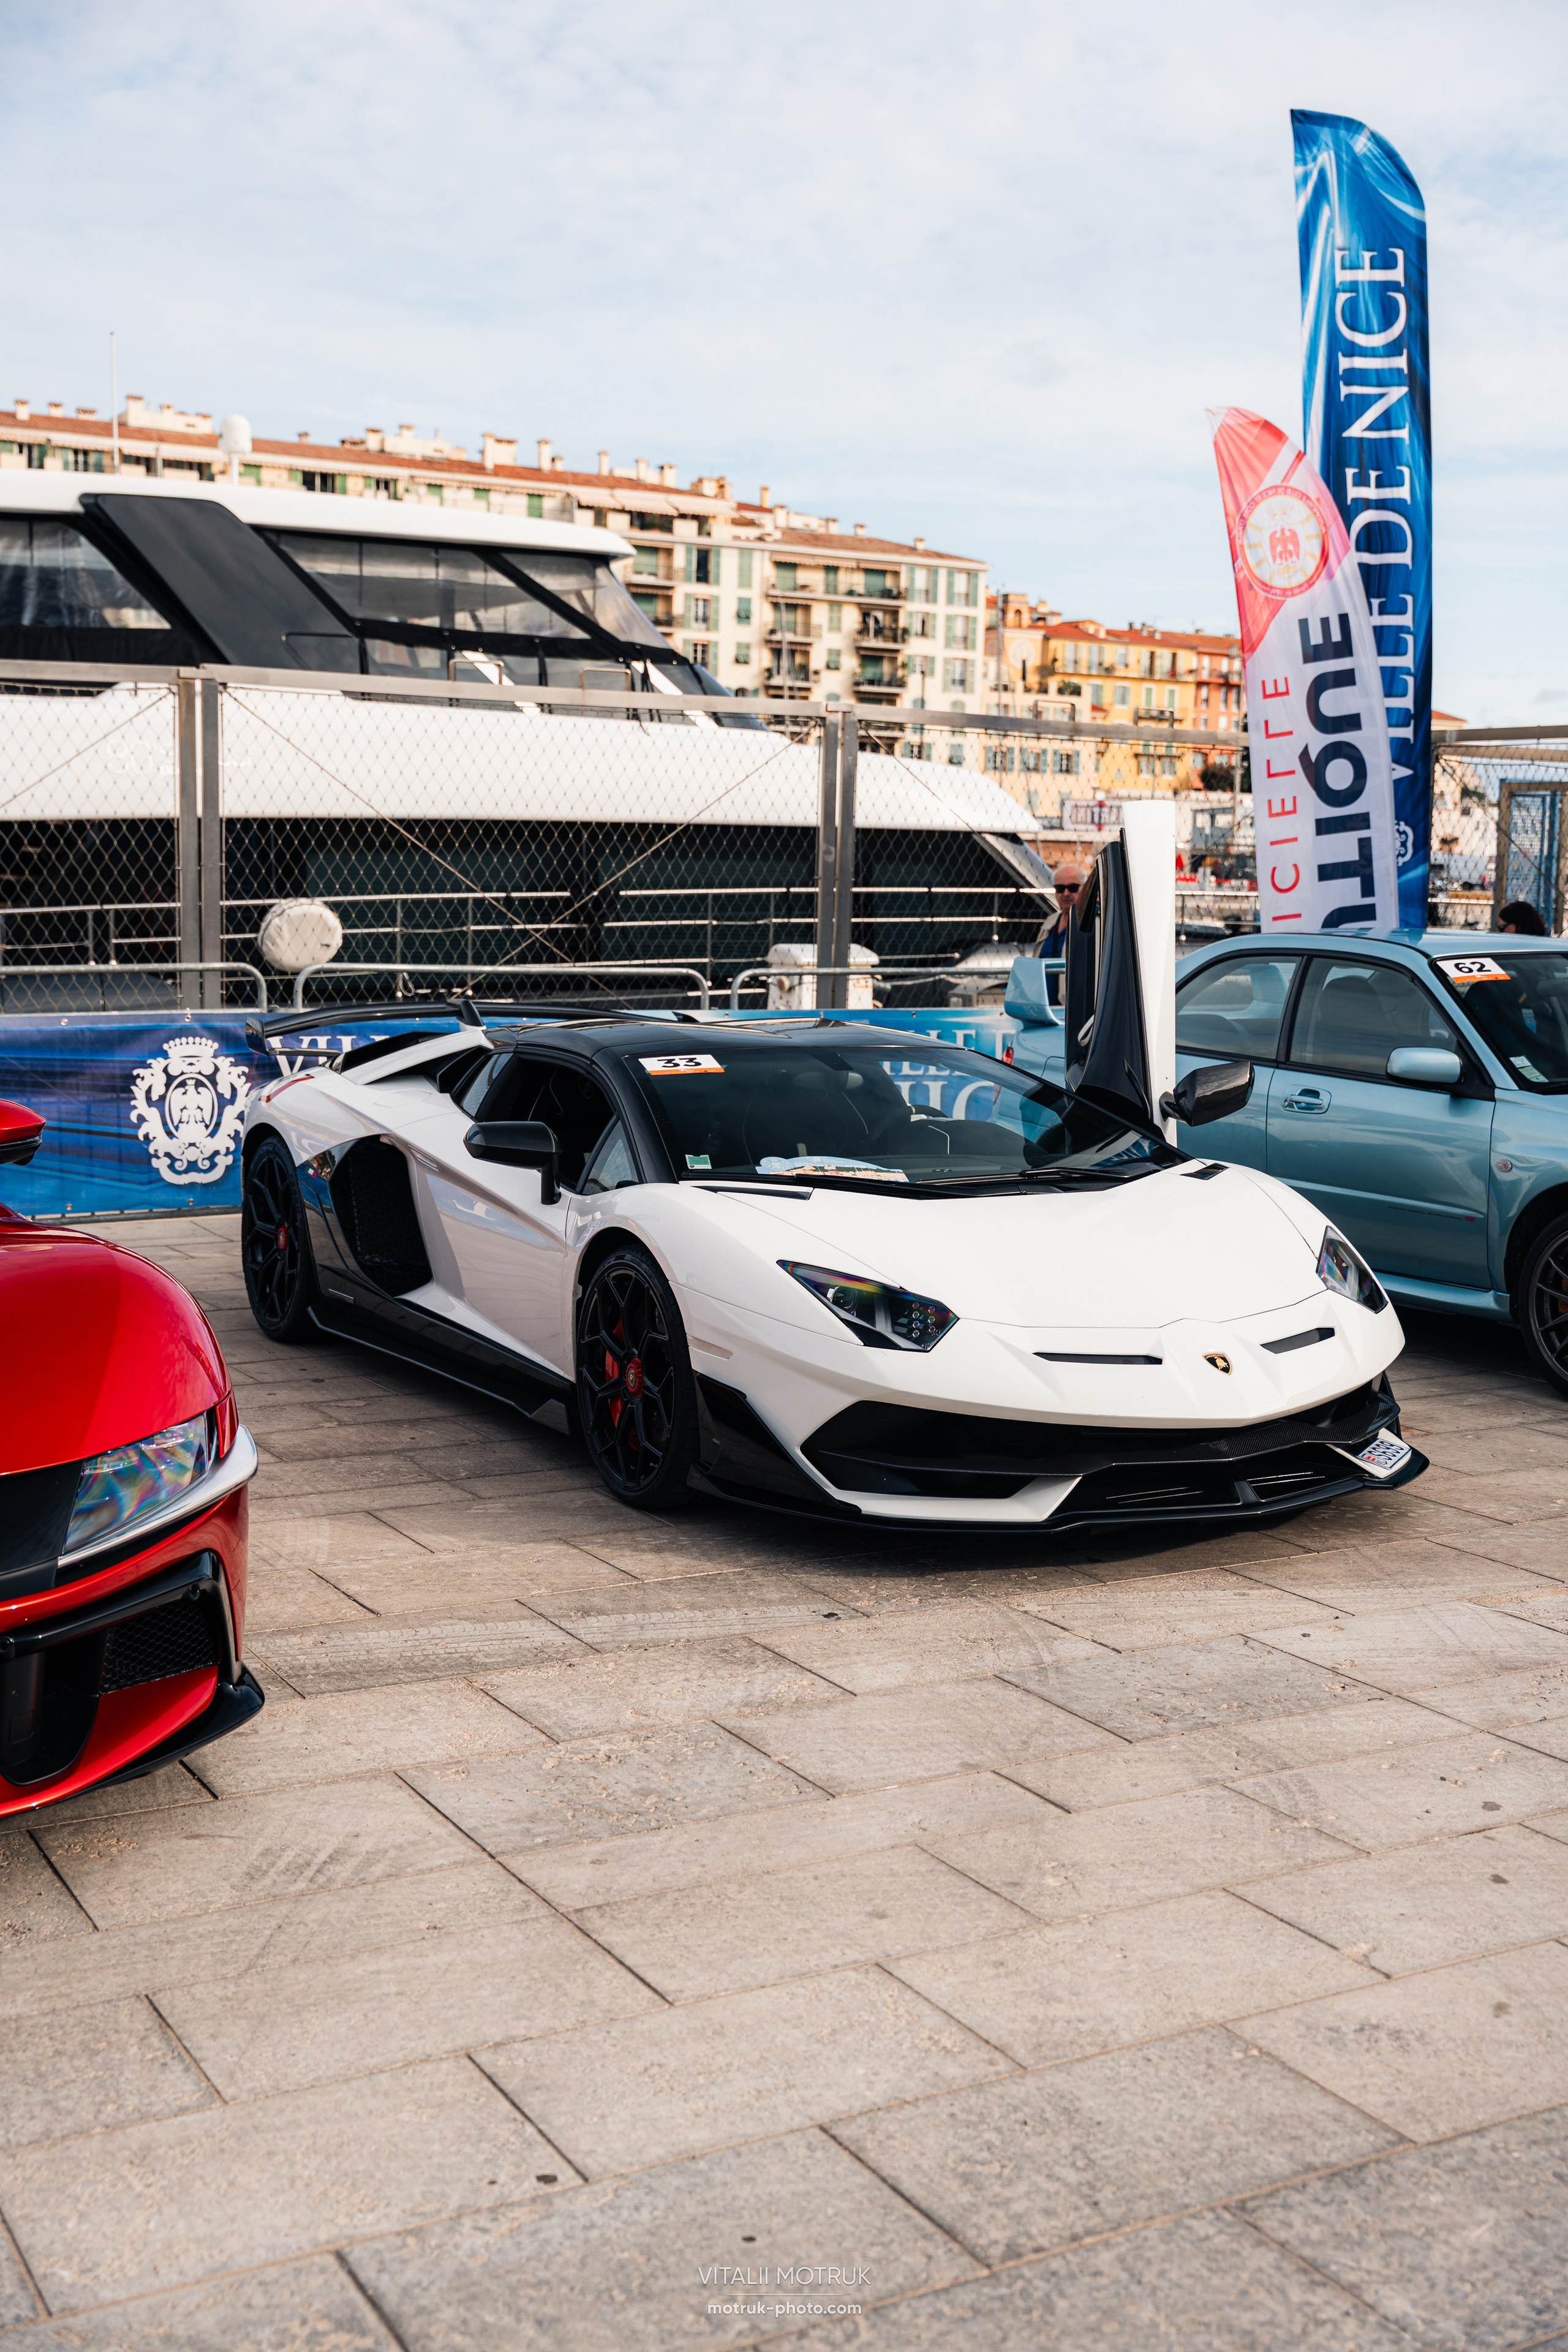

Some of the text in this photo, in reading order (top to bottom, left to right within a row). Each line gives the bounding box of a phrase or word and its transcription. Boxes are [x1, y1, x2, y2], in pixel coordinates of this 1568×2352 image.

[1335, 247, 1410, 445] NICE
[1345, 466, 1413, 570] DE
[1453, 961, 1492, 973] 62
[657, 1057, 702, 1068] 33
